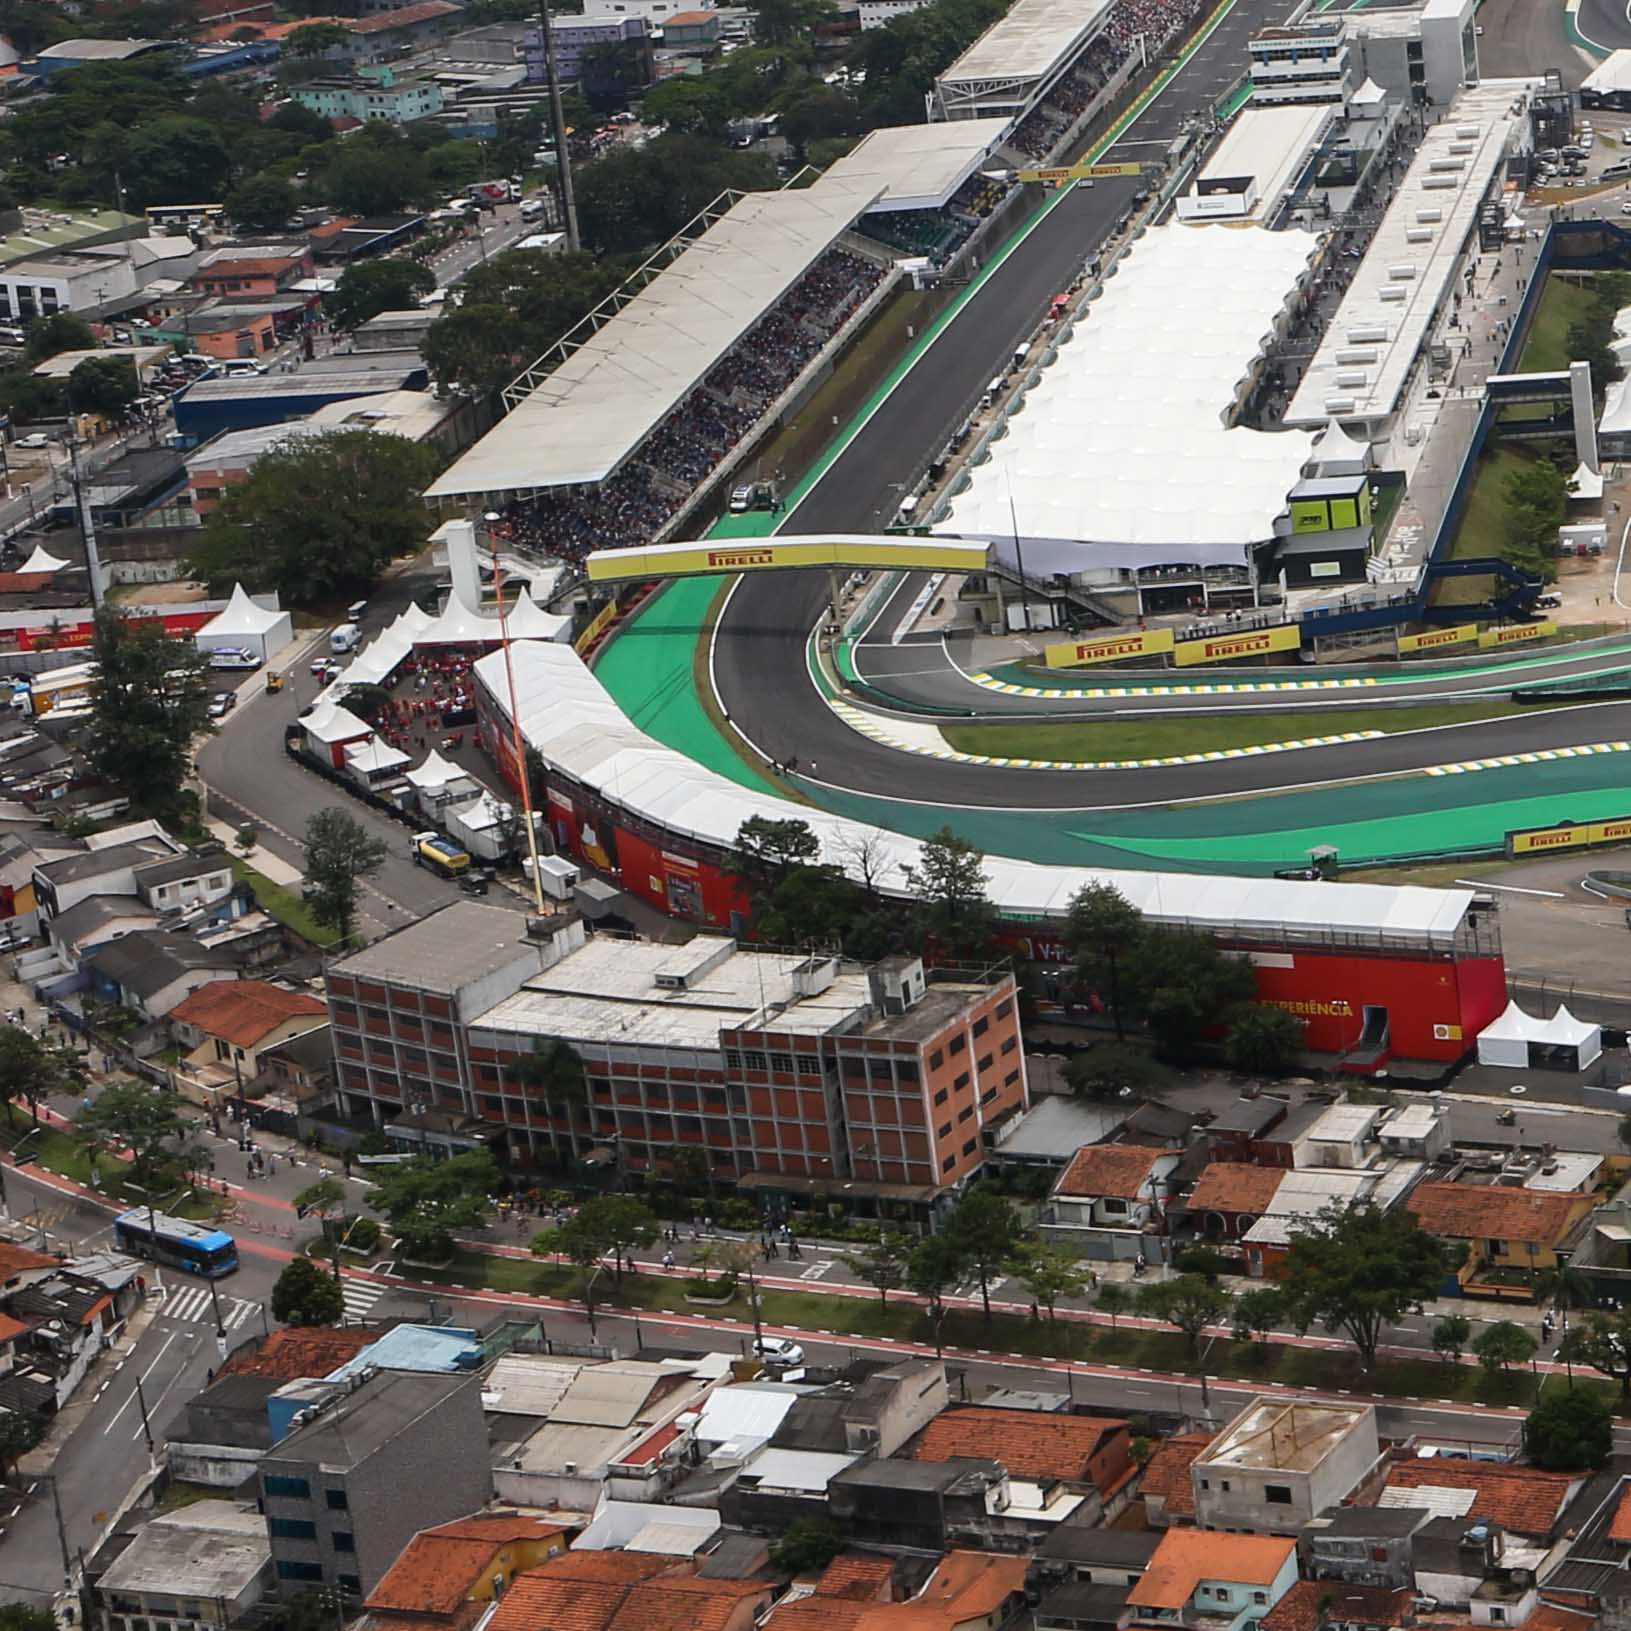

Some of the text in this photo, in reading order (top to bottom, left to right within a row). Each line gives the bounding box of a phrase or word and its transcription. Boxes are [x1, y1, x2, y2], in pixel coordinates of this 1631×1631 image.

[708, 549, 774, 567] PIRELLI
[1416, 629, 1458, 649] PIRELLI
[1496, 624, 1538, 642] PIRELLI
[1076, 637, 1144, 660] PIRELLI
[1205, 633, 1271, 657] PIRELLI
[1529, 831, 1572, 847] PIRELLI
